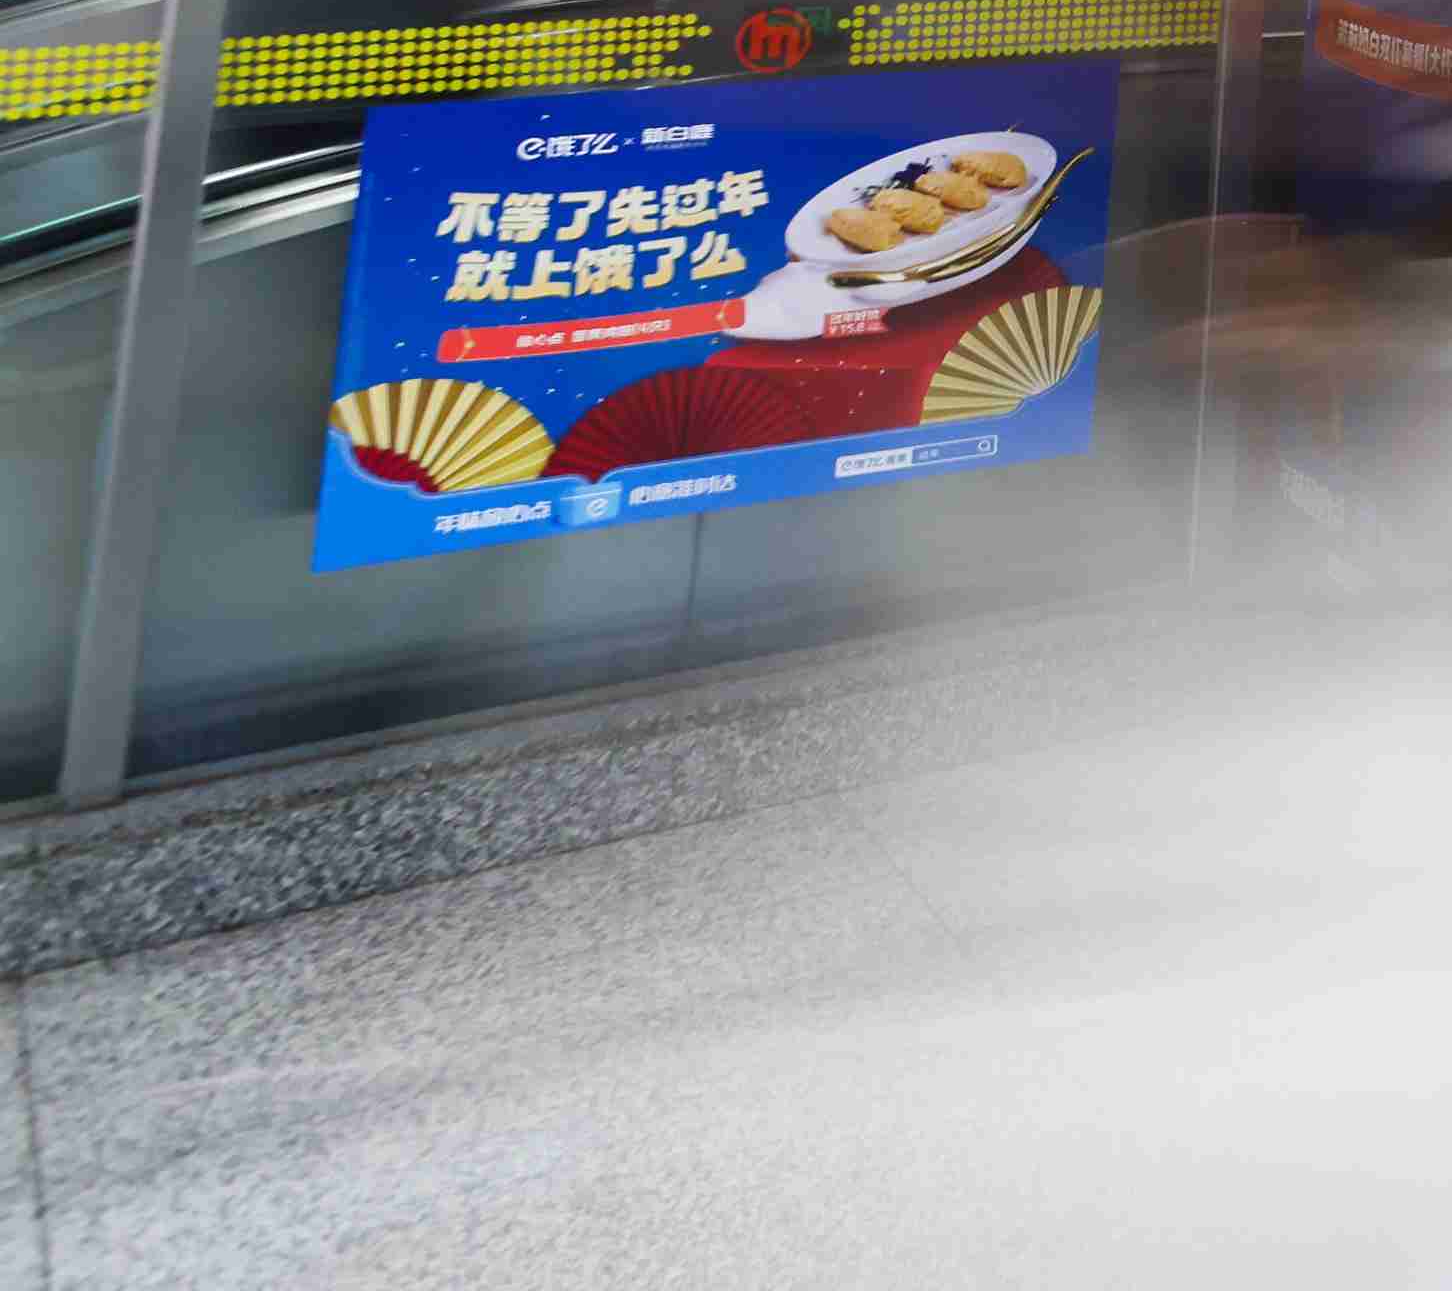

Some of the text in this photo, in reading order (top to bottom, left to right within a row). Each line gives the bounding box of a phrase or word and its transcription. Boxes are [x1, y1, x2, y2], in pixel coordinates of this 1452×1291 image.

[435, 169, 770, 244] 不等了先过年
[443, 230, 747, 303] 就上饿了么
